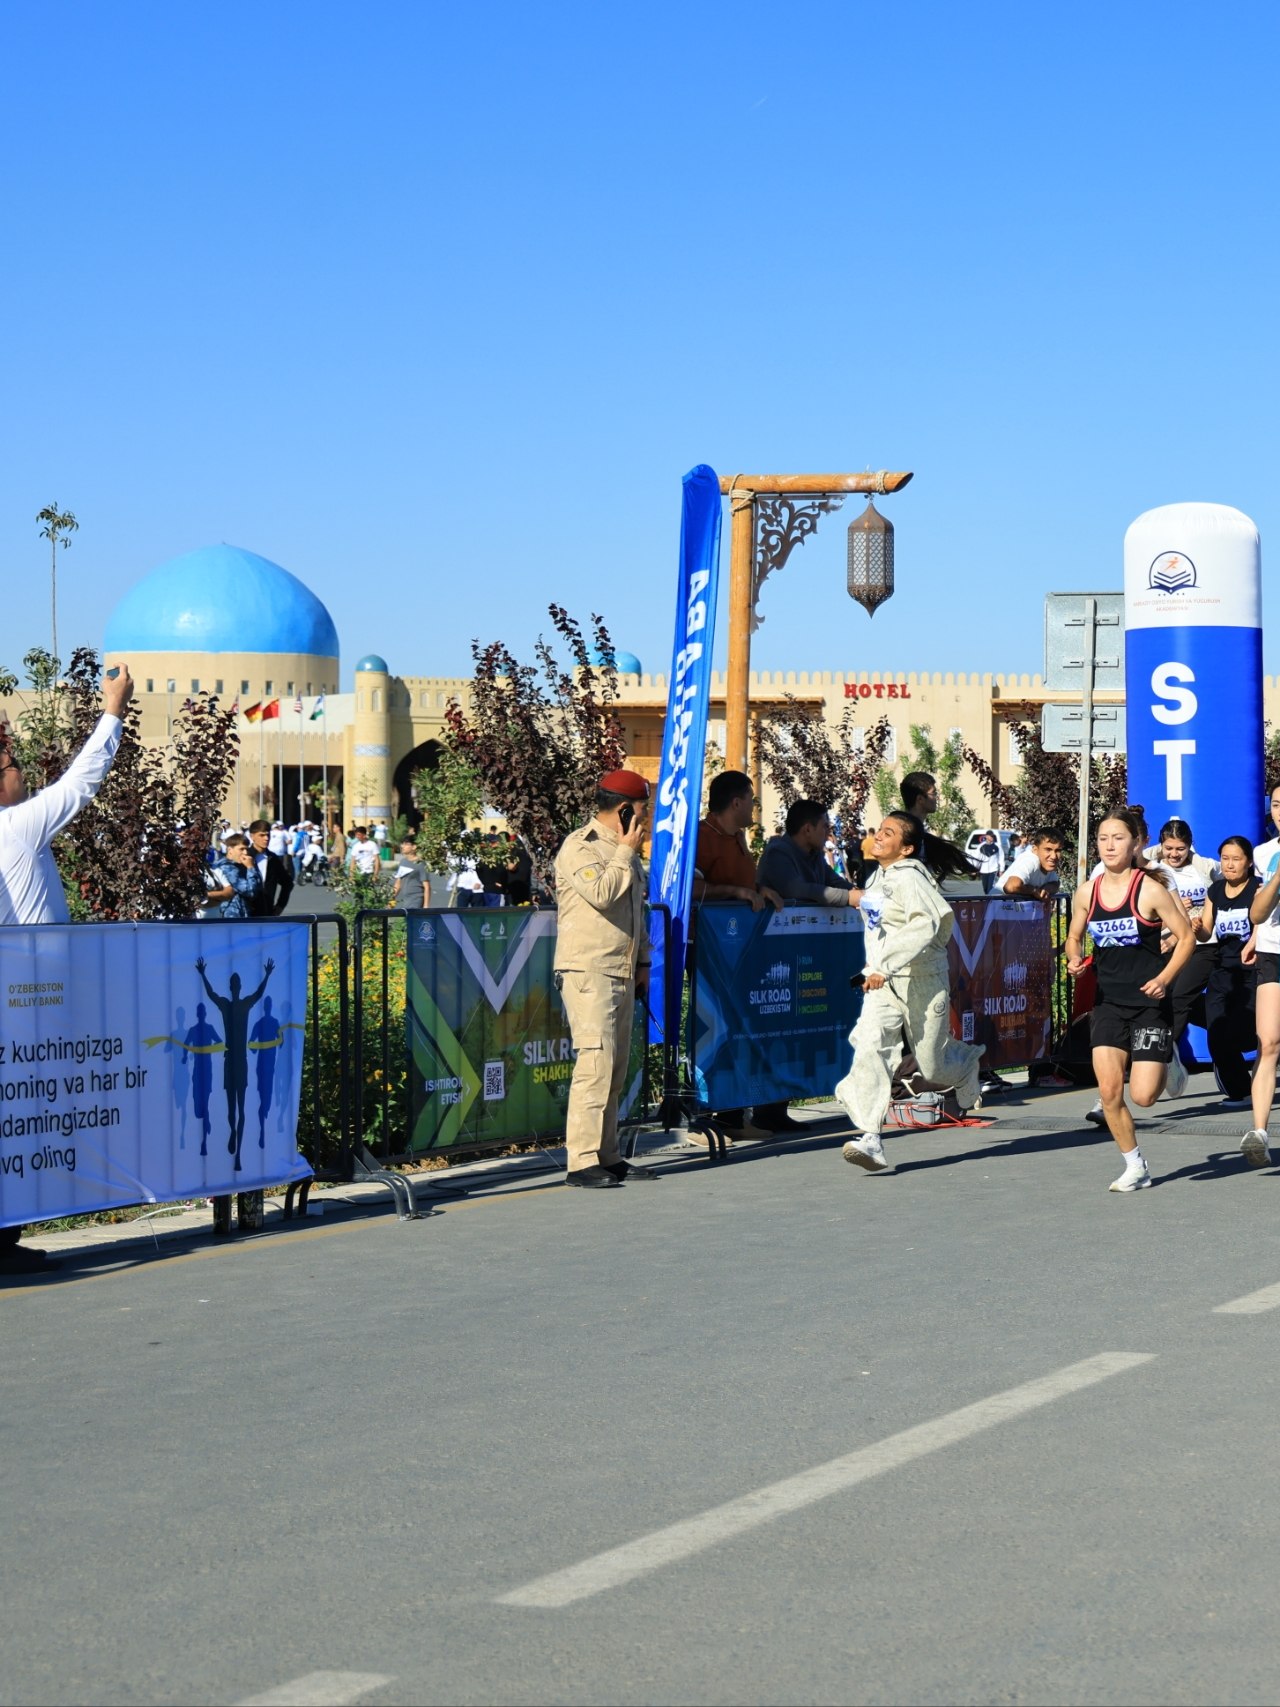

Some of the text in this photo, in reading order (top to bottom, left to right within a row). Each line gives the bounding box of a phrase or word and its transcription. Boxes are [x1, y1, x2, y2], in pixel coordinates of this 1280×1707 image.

[844, 683, 911, 699] HOTEL
[1151, 661, 1198, 820] ST
[1096, 919, 1135, 934] 32662
[1219, 920, 1249, 932] 8423
[749, 988, 791, 1005] SILK ROAD
[984, 994, 1027, 1016] SILK ROAD
[12, 1034, 123, 1064] kuchingizga
[523, 1041, 557, 1065] SILK
[64, 1076, 84, 1095] va
[91, 1070, 119, 1092] har
[125, 1065, 148, 1089] bir
[425, 1076, 464, 1092] ISHTIROK
[441, 1092, 464, 1105] ETISH
[0, 1105, 120, 1138] damingizdan
[0, 1145, 76, 1178] vq oling
